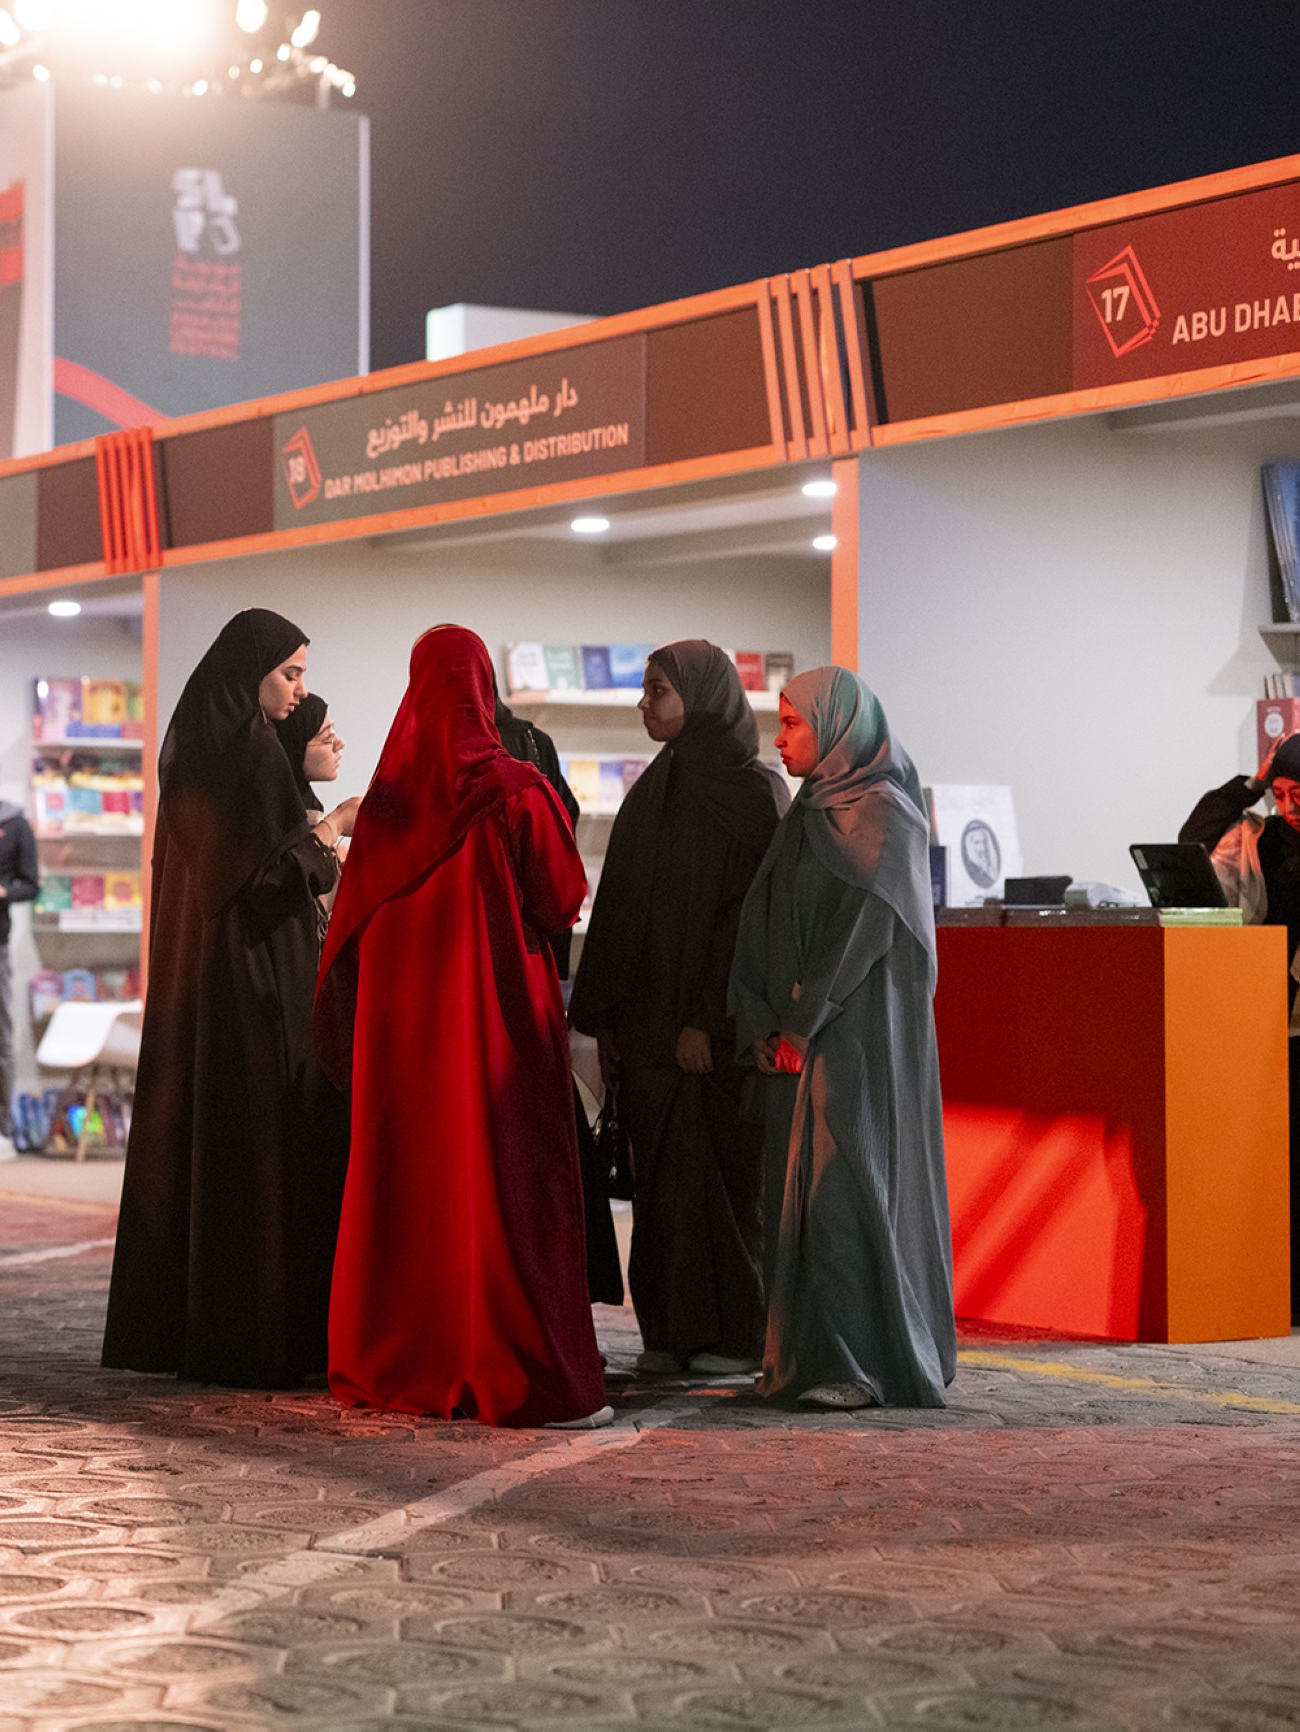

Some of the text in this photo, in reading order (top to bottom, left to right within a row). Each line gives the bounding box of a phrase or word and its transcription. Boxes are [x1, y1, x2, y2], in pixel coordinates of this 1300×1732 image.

[1101, 285, 1130, 324] 17
[1171, 306, 1227, 345] ABU
[366, 377, 579, 459] دار ملهمون للنشر والتوزيع
[324, 475, 351, 499] DAR
[424, 445, 507, 481] PUBLISHING
[509, 442, 521, 465] &
[523, 422, 629, 463] DISTRIBUTION
